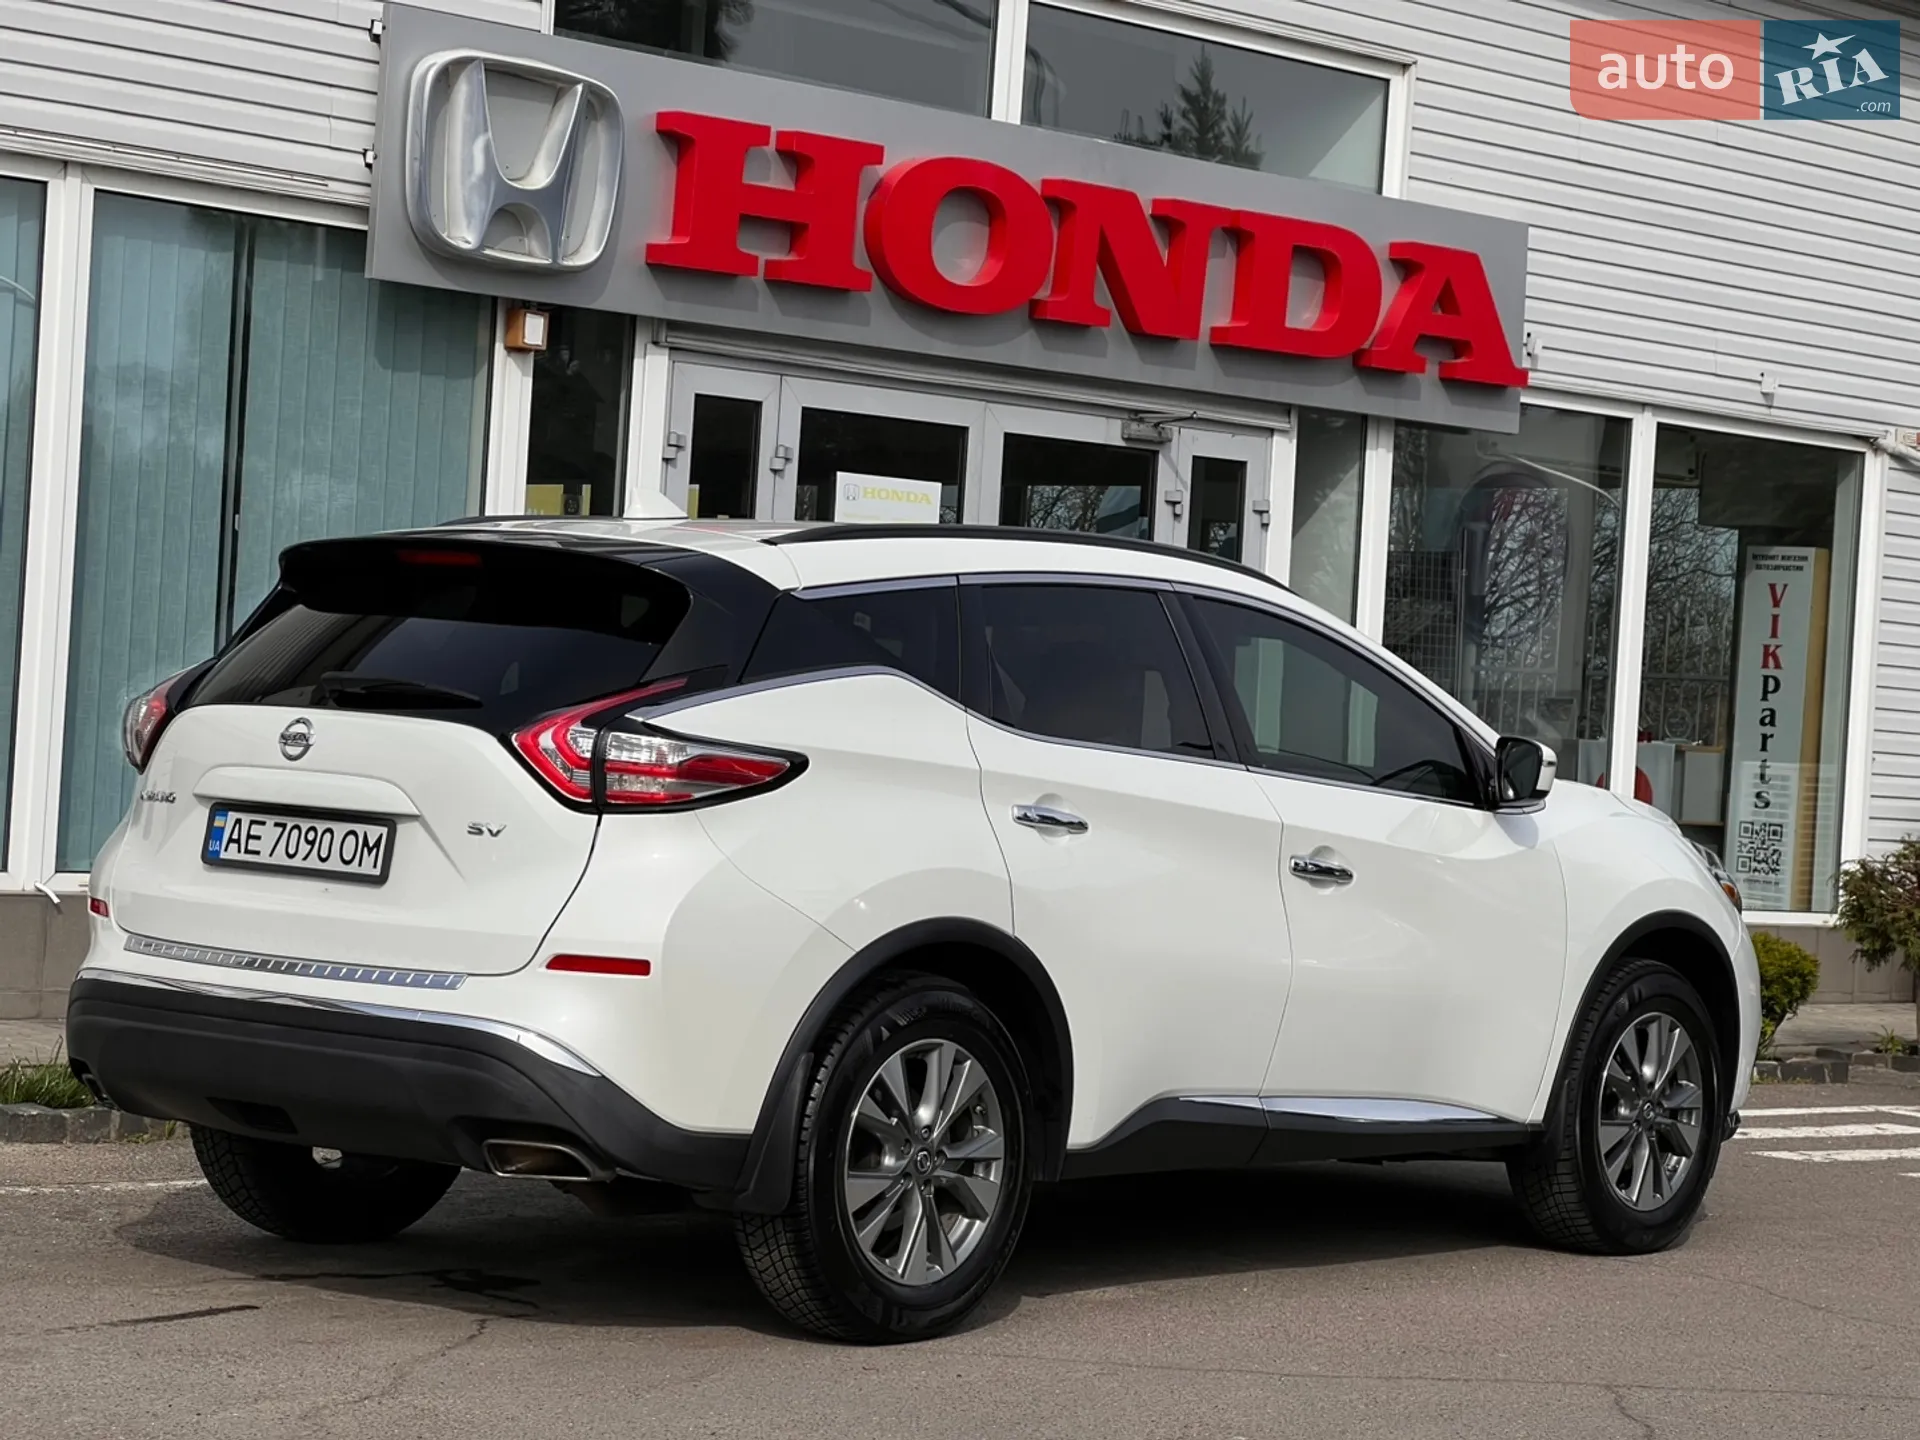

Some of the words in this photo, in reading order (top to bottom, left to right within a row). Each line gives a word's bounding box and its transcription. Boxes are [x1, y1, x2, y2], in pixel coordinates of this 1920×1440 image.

[646, 111, 1529, 388] HONDA
[862, 486, 932, 505] HONDA
[466, 821, 507, 838] SV
[208, 840, 220, 852] UA
[224, 818, 266, 856] AE
[269, 821, 334, 863] 7090
[339, 829, 383, 869] OM
